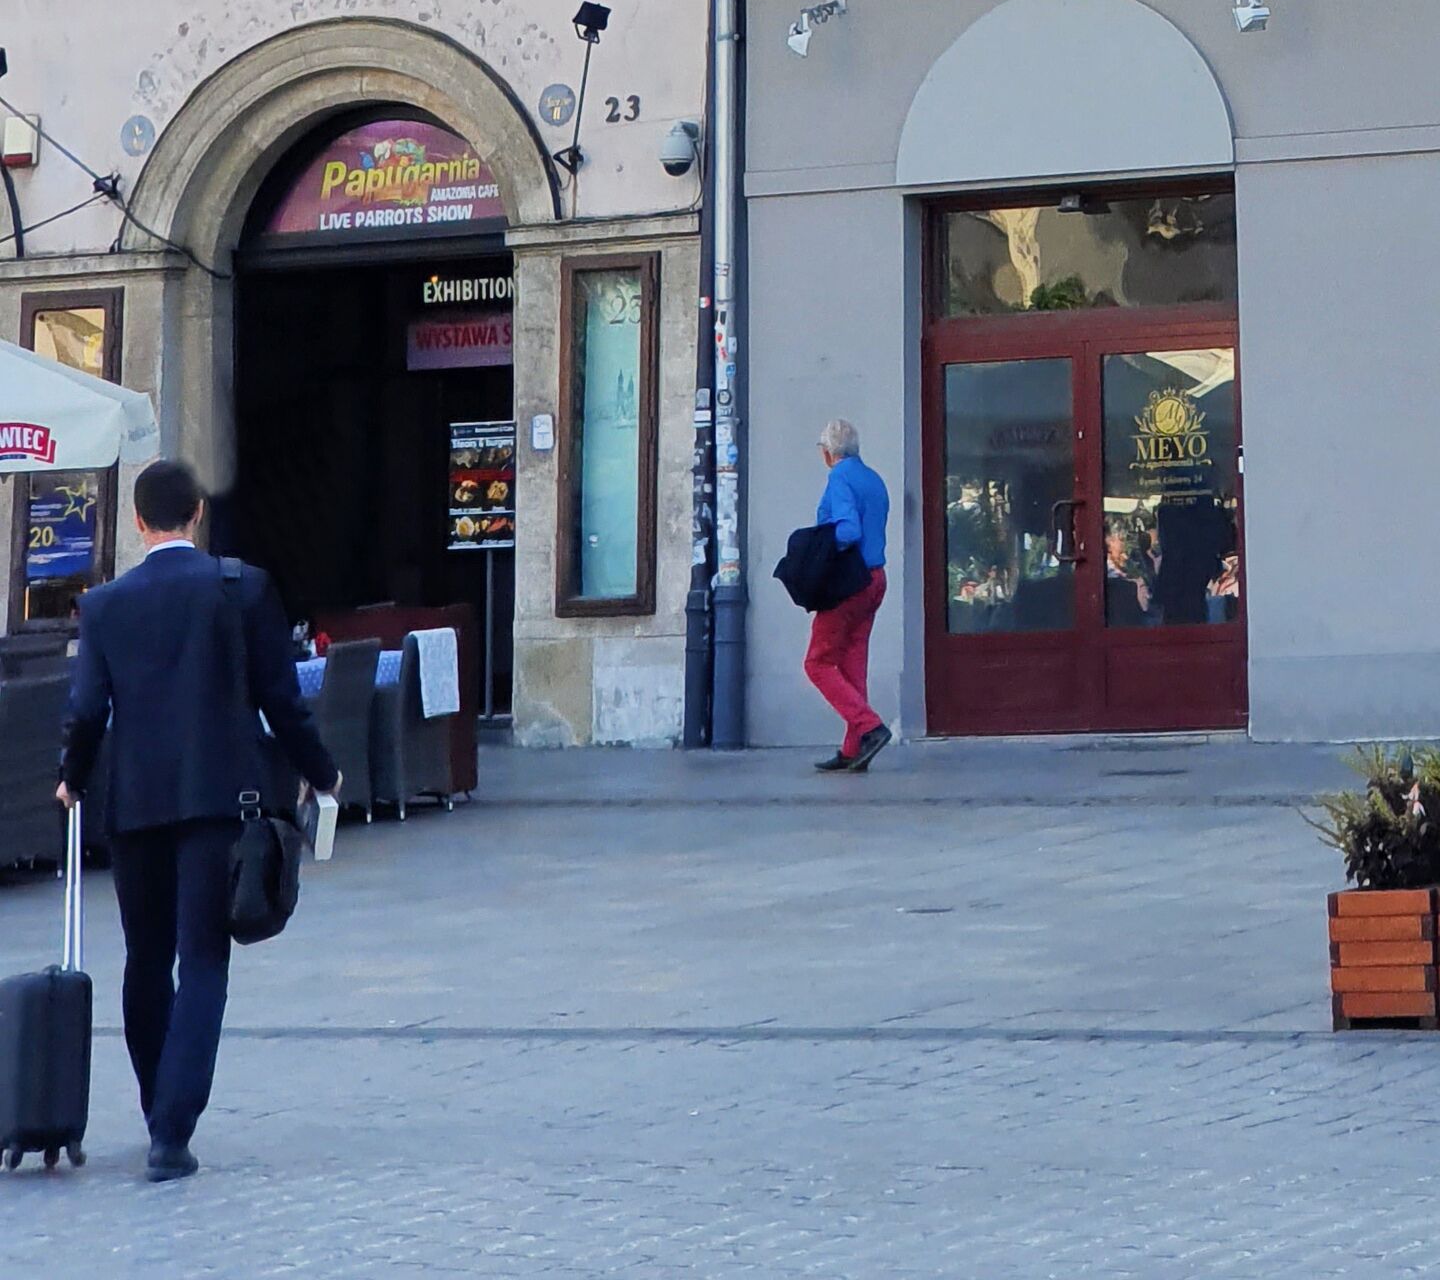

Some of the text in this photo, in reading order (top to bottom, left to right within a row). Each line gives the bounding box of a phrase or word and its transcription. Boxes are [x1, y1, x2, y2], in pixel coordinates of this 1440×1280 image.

[605, 95, 640, 122] 23
[321, 153, 480, 202] Papugarnia
[320, 204, 473, 230] LIVE PARROTS SHOW
[1136, 434, 1207, 460] MEYO
[29, 526, 54, 548] 20
